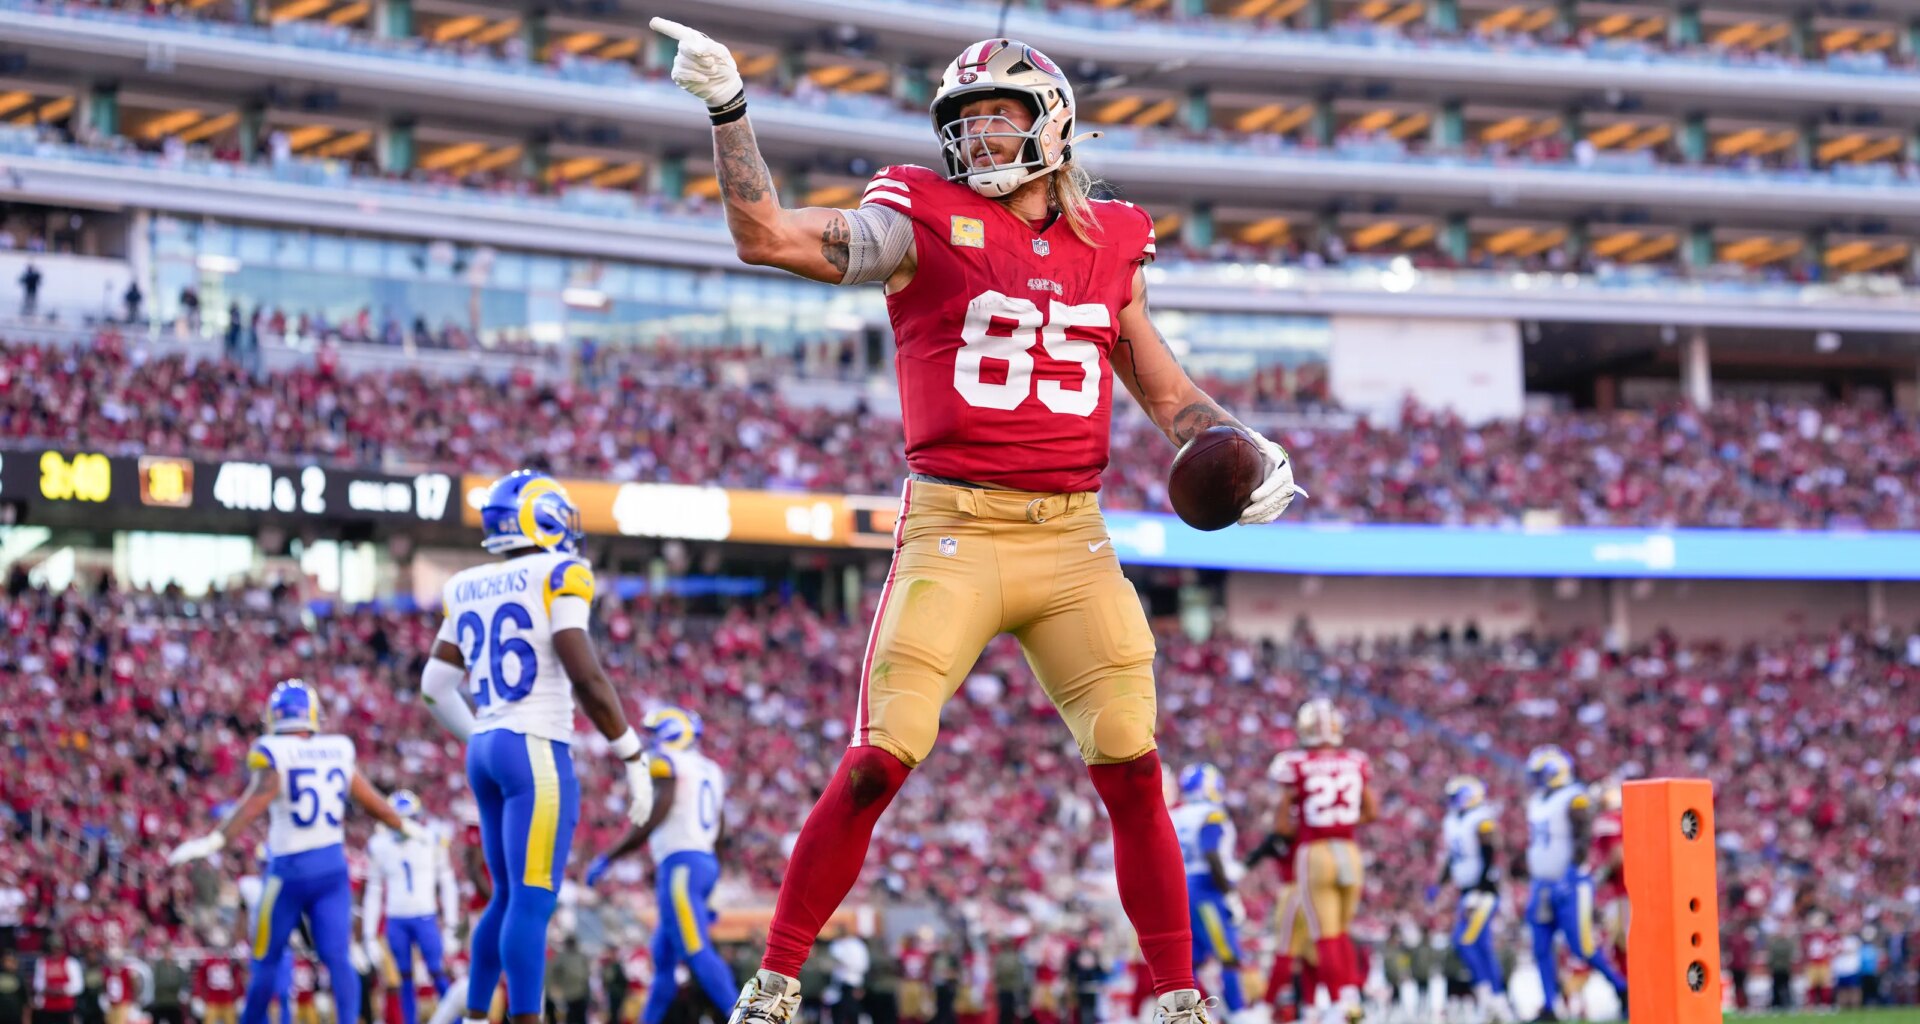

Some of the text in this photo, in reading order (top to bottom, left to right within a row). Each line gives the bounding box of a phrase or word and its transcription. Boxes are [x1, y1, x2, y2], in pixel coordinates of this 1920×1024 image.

[953, 289, 1112, 417] 85
[40, 452, 110, 501] 3:40
[301, 466, 325, 513] 2
[455, 568, 529, 603] KINCHENS
[456, 602, 538, 709] 26
[288, 767, 347, 829] 53
[698, 778, 717, 832] 0
[1303, 774, 1363, 828] 23
[403, 859, 413, 893] 1
